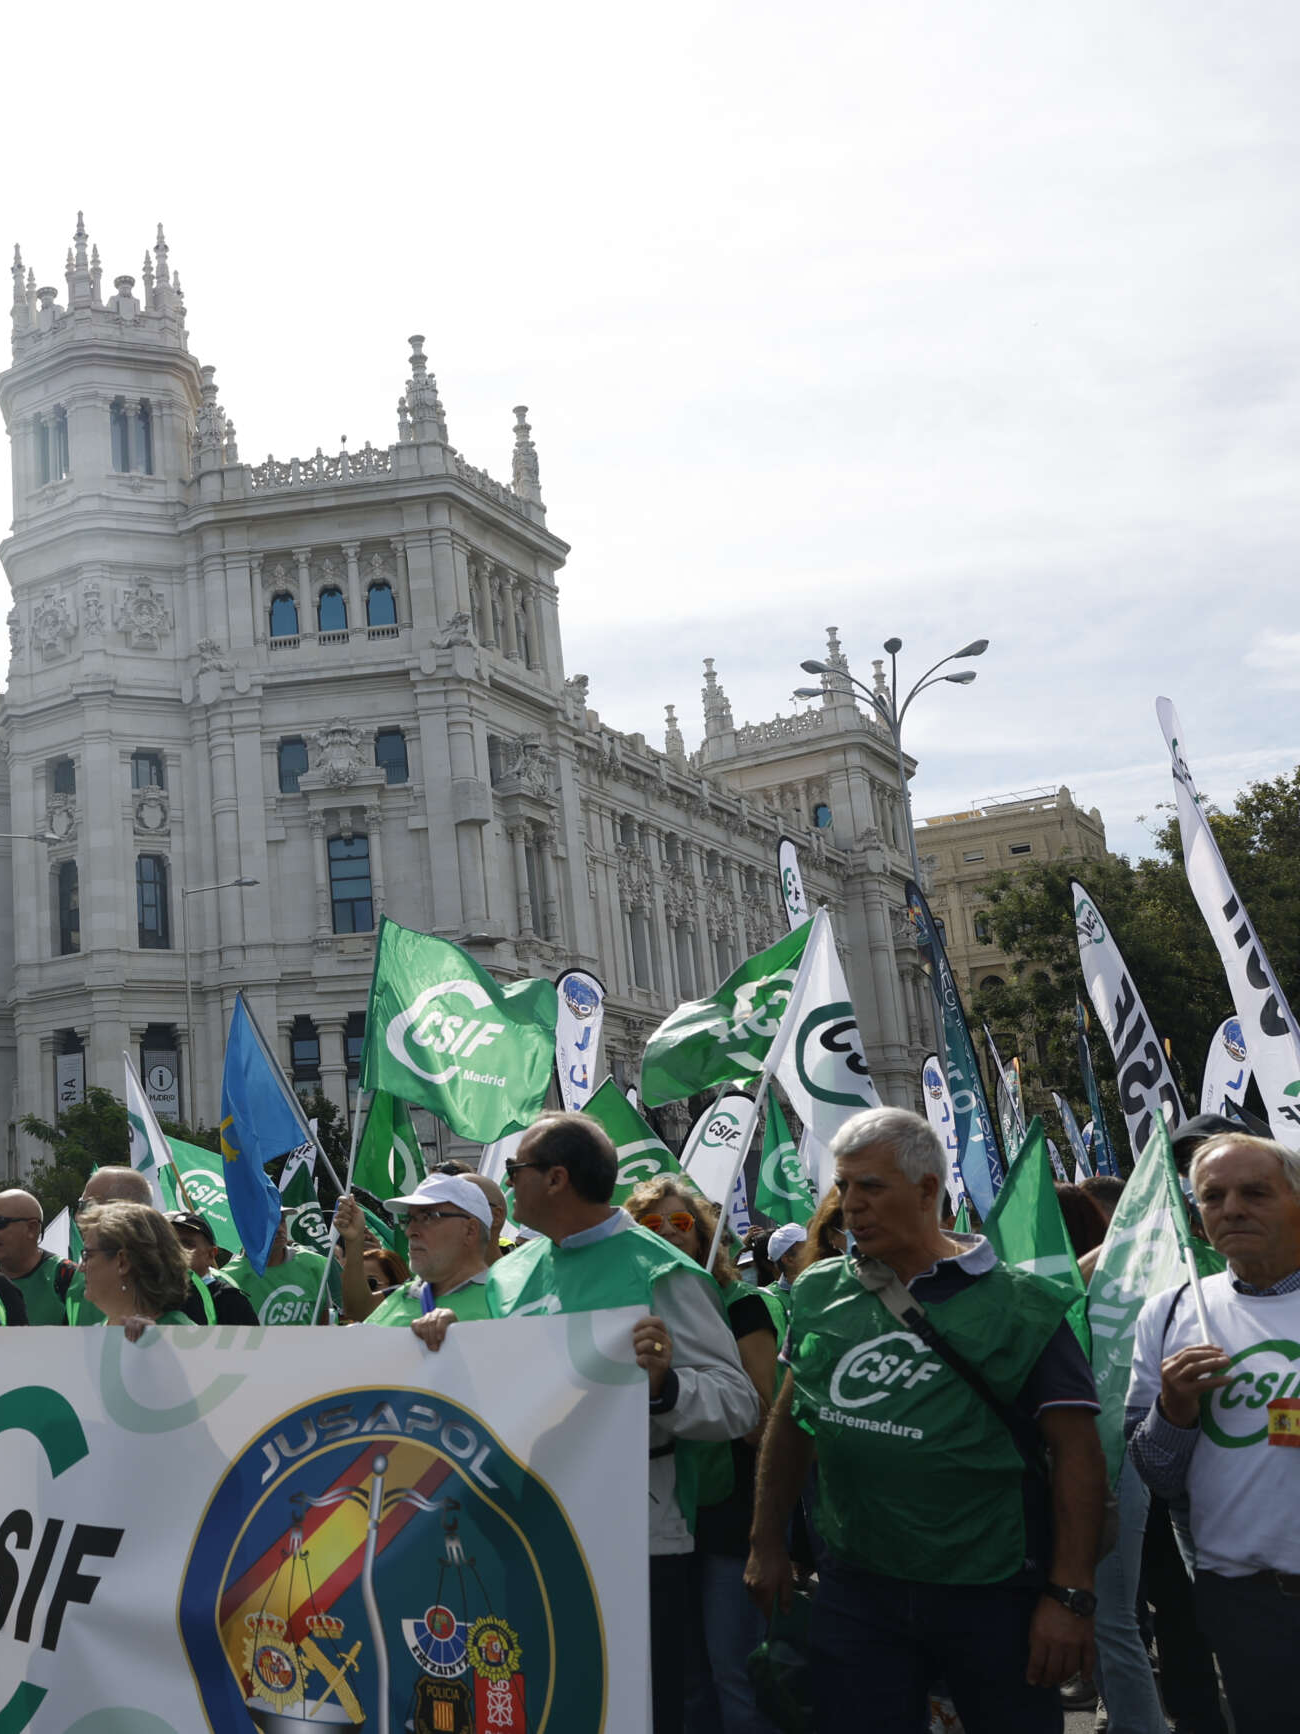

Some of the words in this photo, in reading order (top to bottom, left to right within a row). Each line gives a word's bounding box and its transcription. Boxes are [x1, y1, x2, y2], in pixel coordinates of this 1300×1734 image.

[412, 1011, 505, 1057] CSIF
[463, 1070, 506, 1087] Madrid
[708, 1121, 742, 1142] CSIF
[185, 1179, 228, 1206] CSIF
[268, 1301, 311, 1325] CSIF
[818, 1406, 924, 1440] Extremadura
[260, 1401, 499, 1490] JUSAPOL
